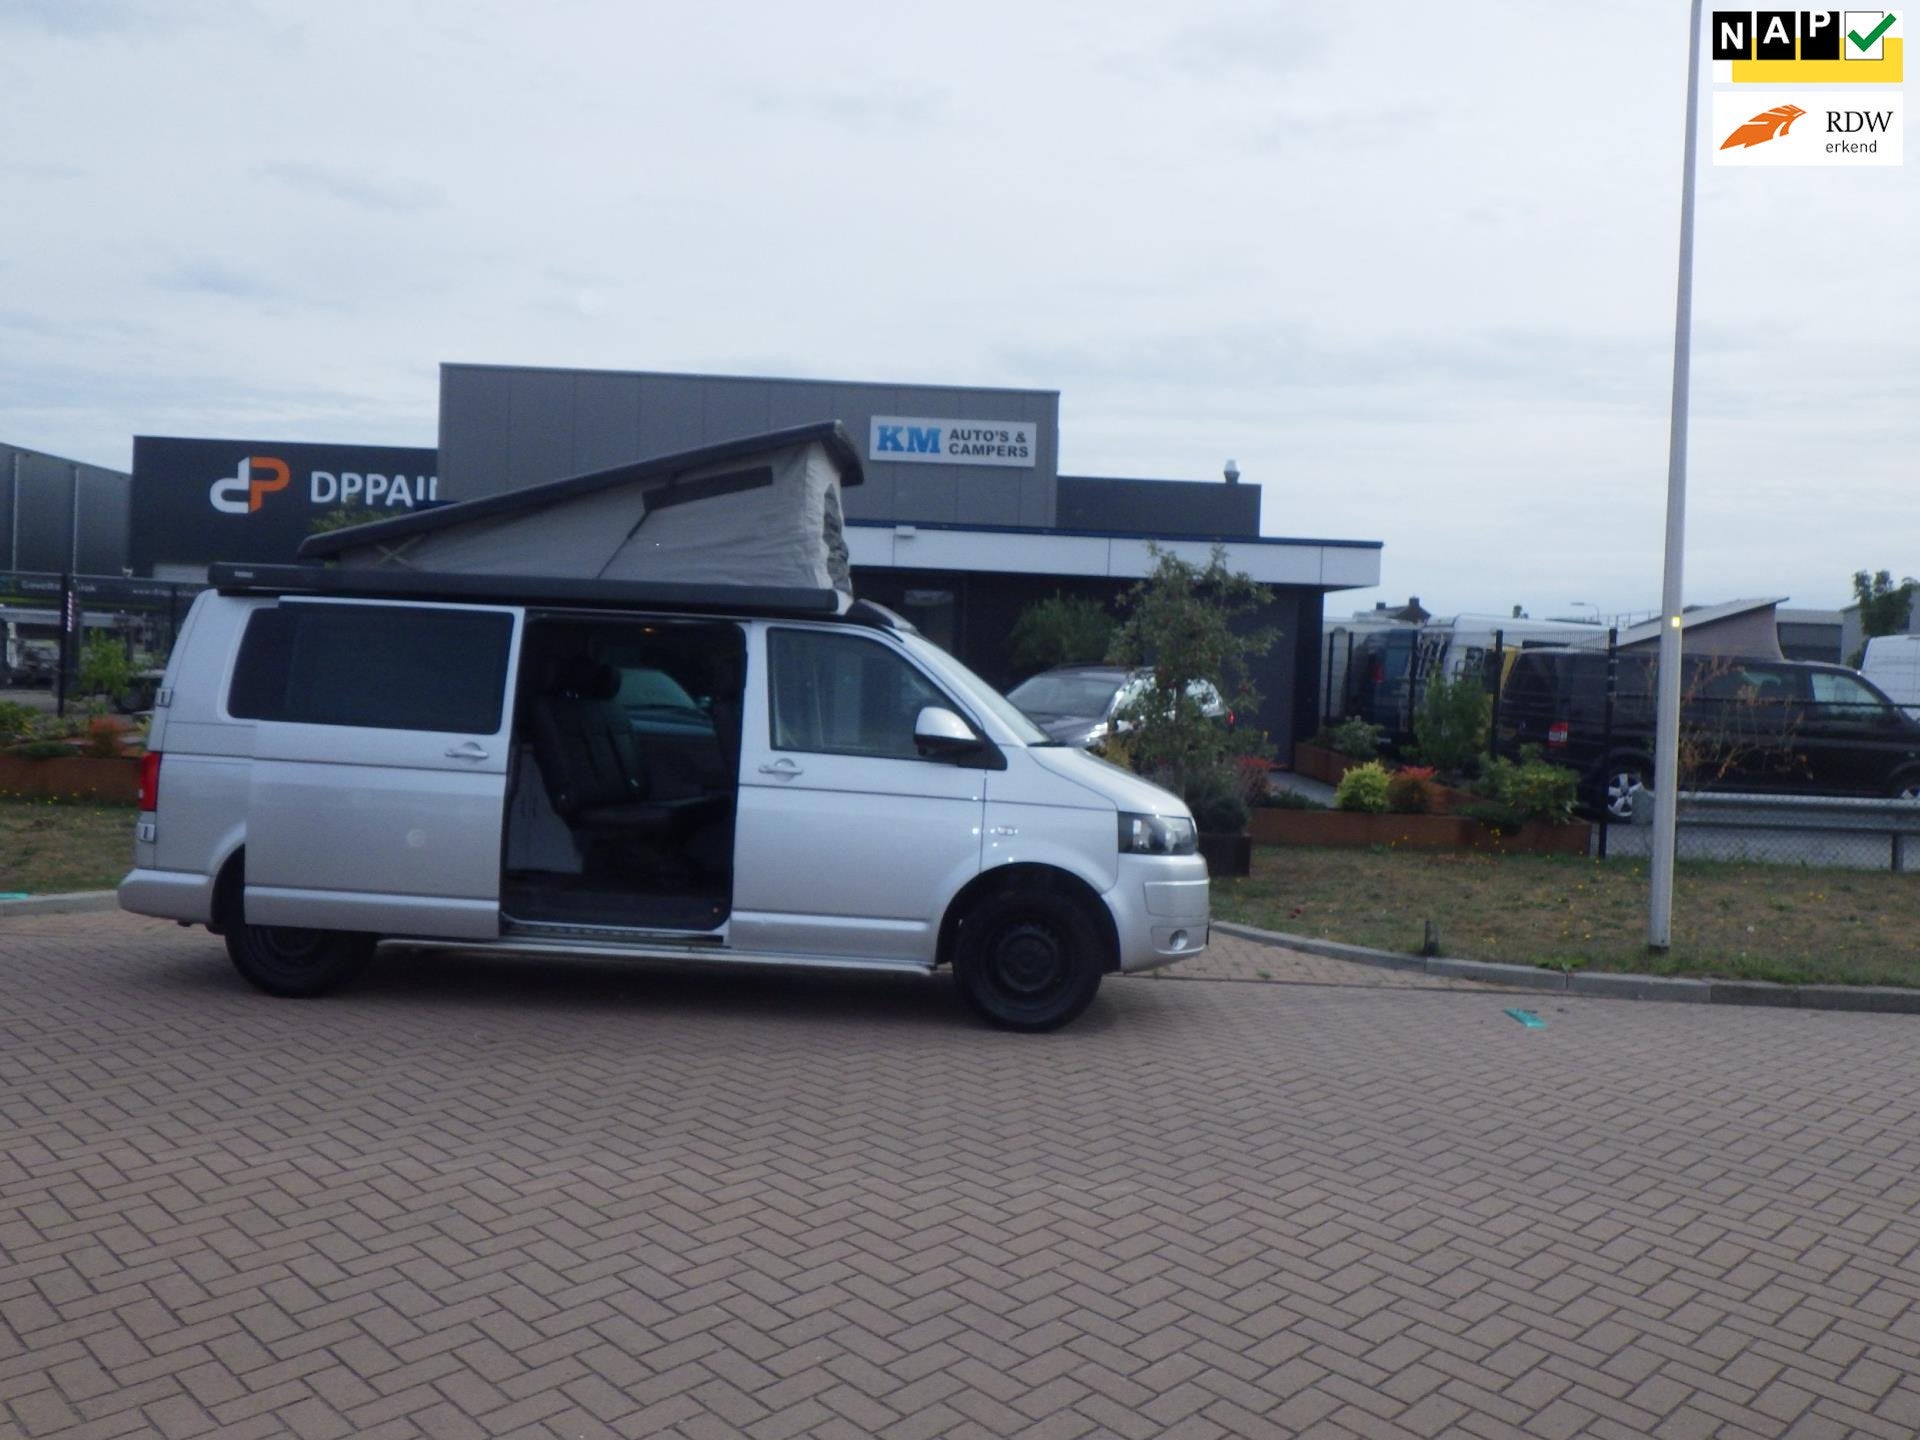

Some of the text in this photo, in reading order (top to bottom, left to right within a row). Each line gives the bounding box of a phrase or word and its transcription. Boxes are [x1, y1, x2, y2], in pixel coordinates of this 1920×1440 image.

[876, 425, 942, 454] KM
[949, 428, 1026, 444] AUTO'S &
[949, 443, 1029, 458] CAMPERS
